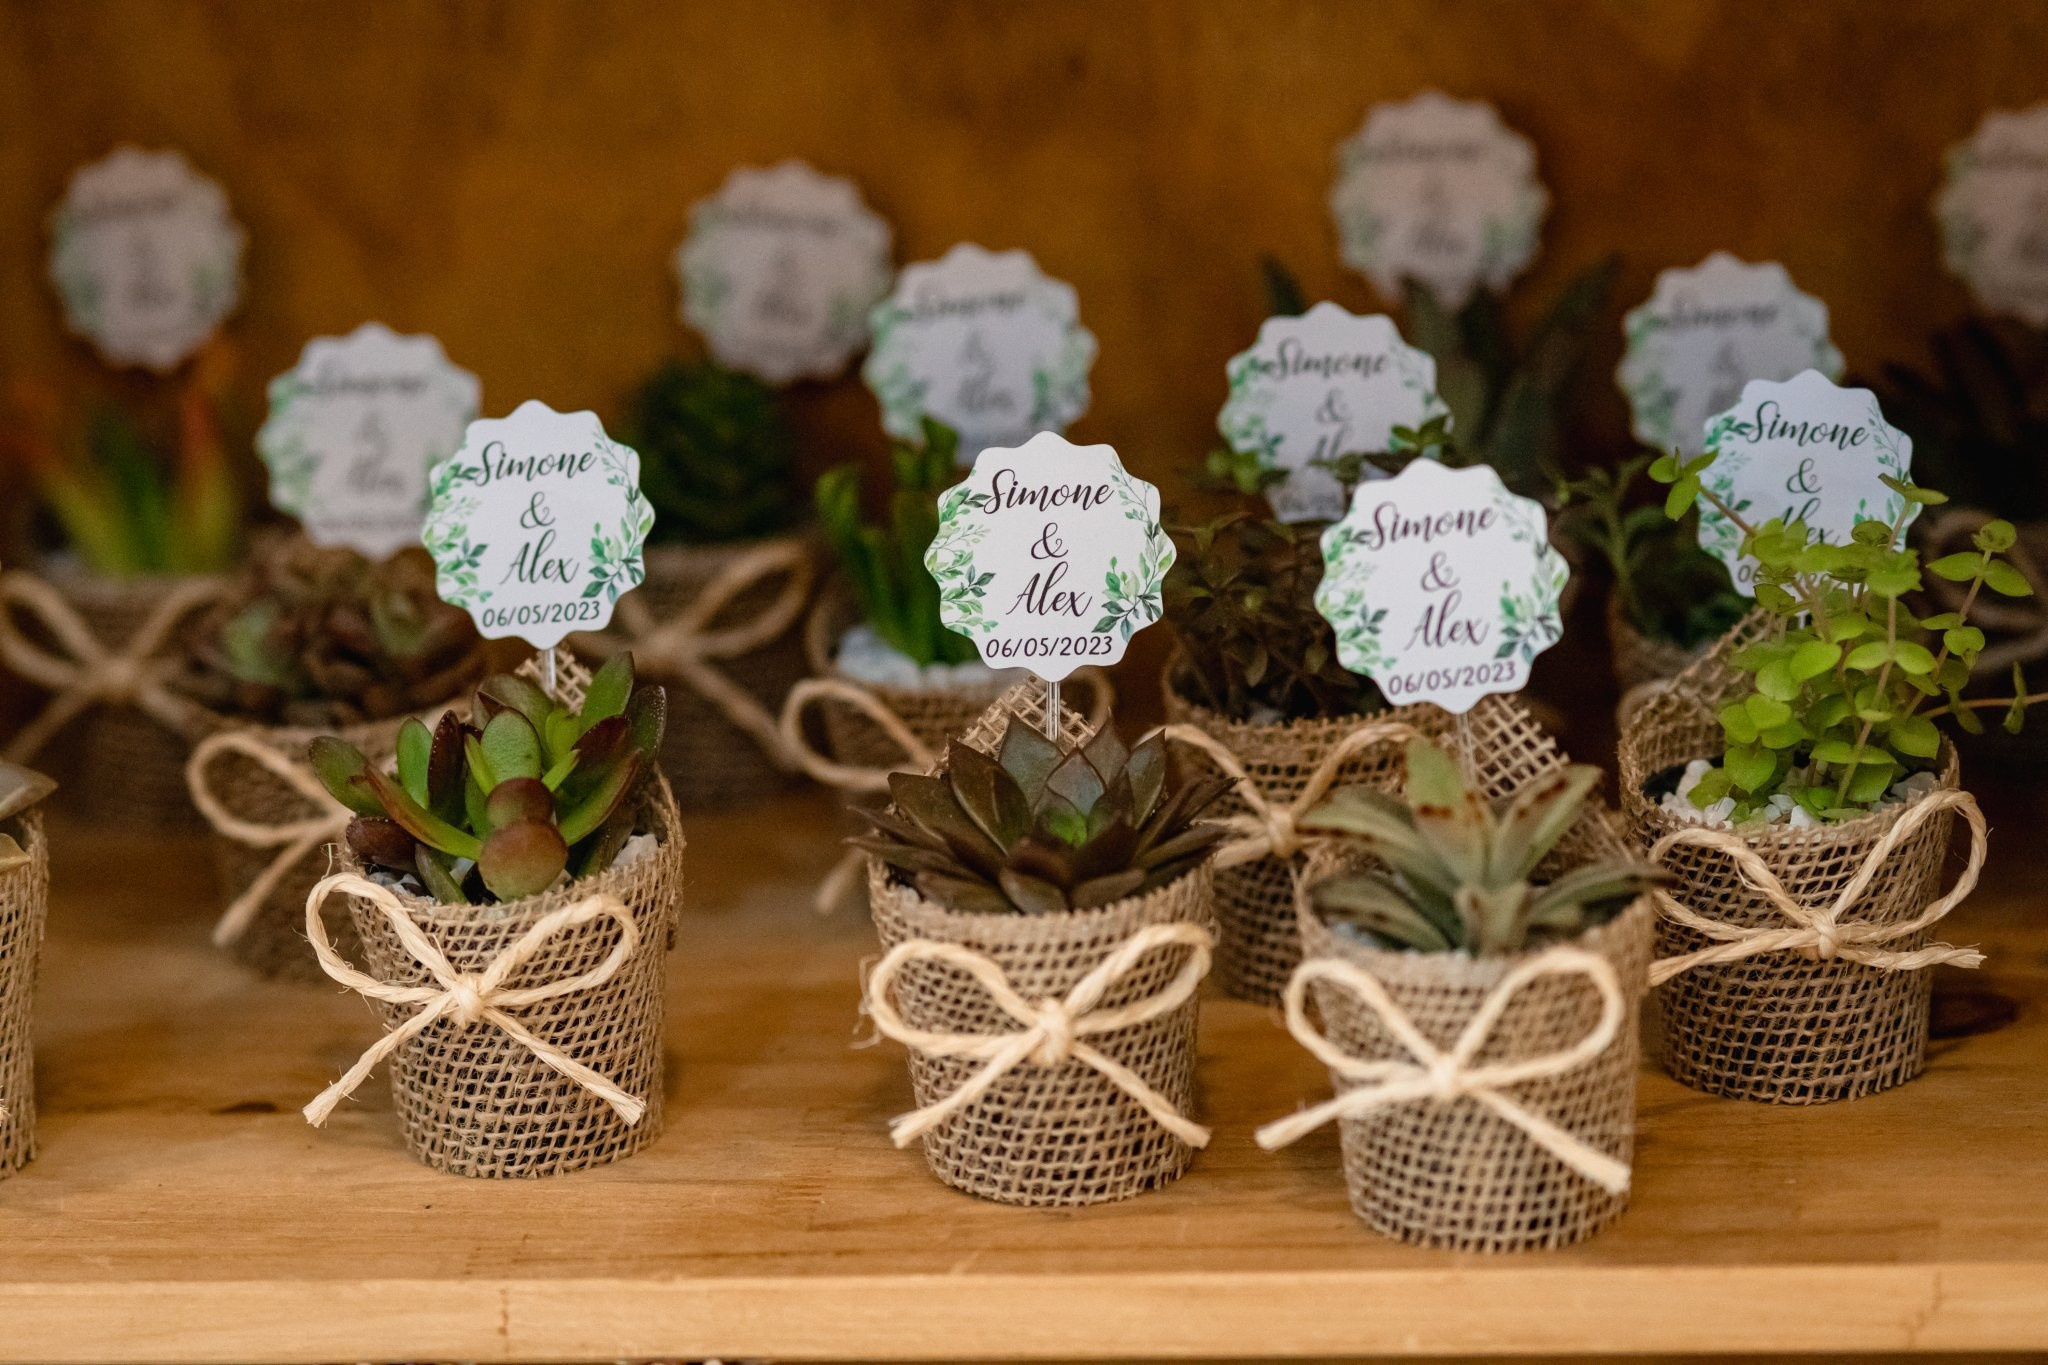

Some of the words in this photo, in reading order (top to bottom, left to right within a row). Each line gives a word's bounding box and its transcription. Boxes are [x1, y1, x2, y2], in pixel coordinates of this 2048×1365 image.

[1272, 337, 1388, 382] Simone
[1315, 389, 1350, 423] &
[1746, 400, 1870, 451] Simone
[475, 440, 597, 487] Simone
[1786, 458, 1823, 494] &
[520, 491, 556, 529] &
[983, 468, 1115, 515] Simone
[1031, 522, 1069, 560] &
[1368, 501, 1497, 551] Simone
[500, 529, 580, 585] Alex
[1420, 550, 1461, 592] &
[1005, 561, 1093, 617] Alex
[482, 600, 601, 628] 06/05/2023
[1405, 589, 1490, 650] Alex
[985, 635, 1113, 658] 06/05/2023
[1388, 661, 1516, 696] 06/05/2023
